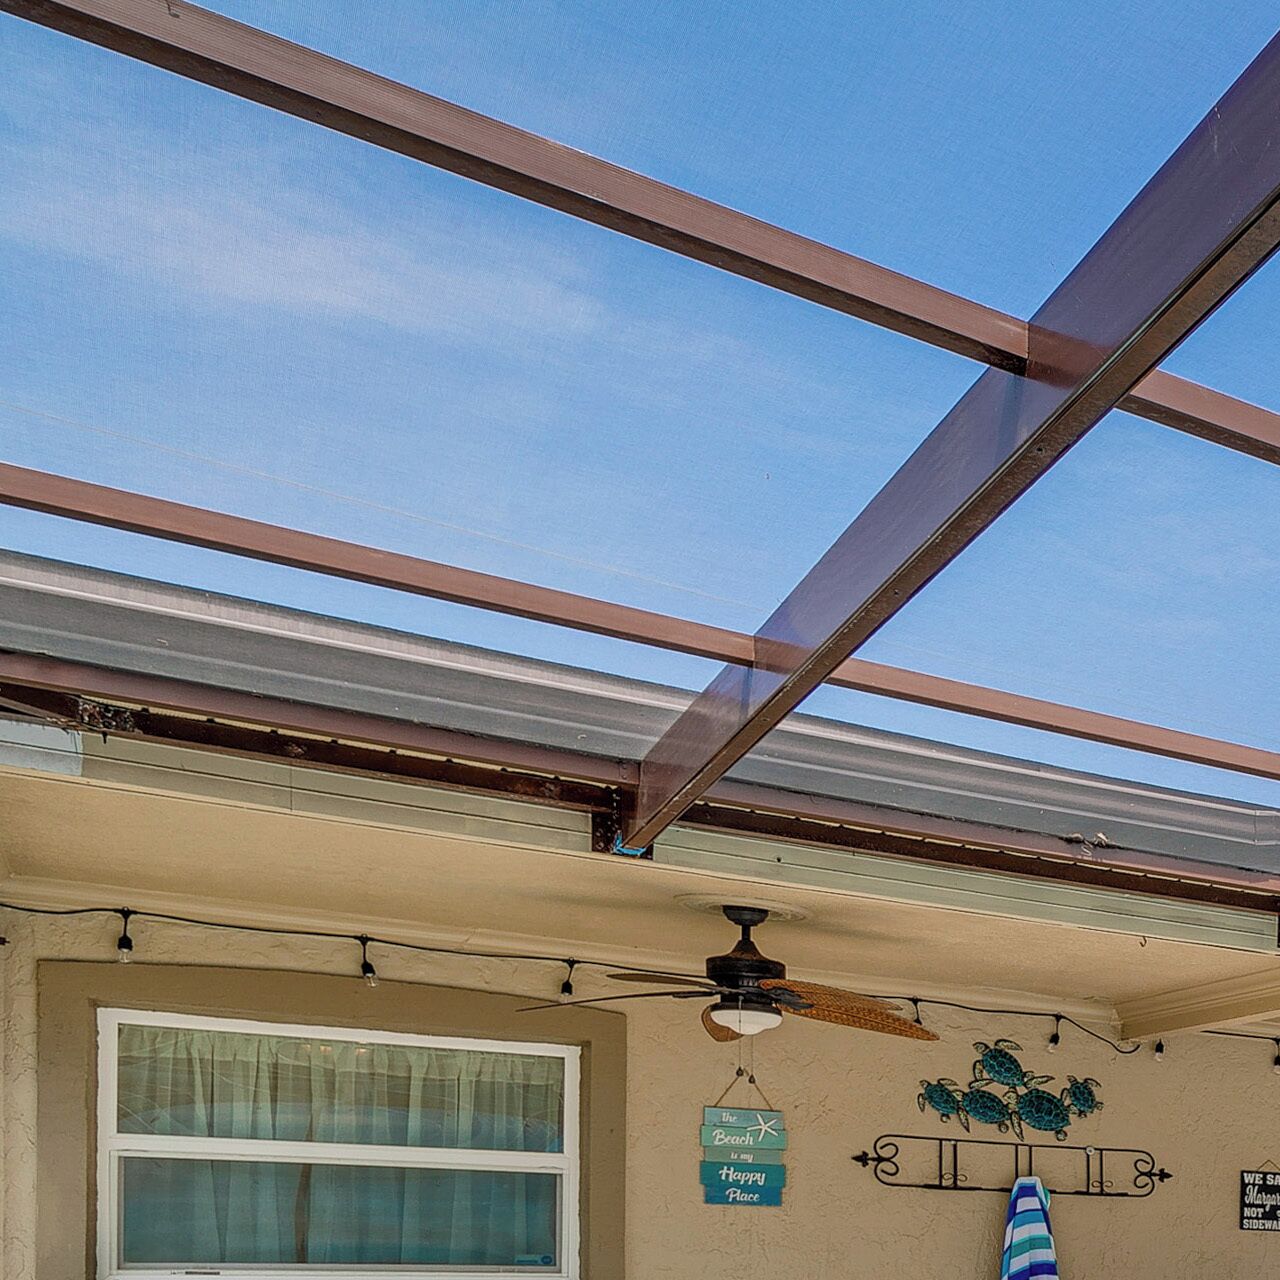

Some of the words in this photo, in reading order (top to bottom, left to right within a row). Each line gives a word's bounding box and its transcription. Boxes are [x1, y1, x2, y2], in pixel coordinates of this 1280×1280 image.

[712, 1129, 754, 1145] Beach
[739, 1153, 754, 1163] my
[719, 1165, 766, 1186] Happy
[1243, 1172, 1263, 1185] WE
[725, 1187, 760, 1202] Place
[1243, 1207, 1264, 1218] NOT
